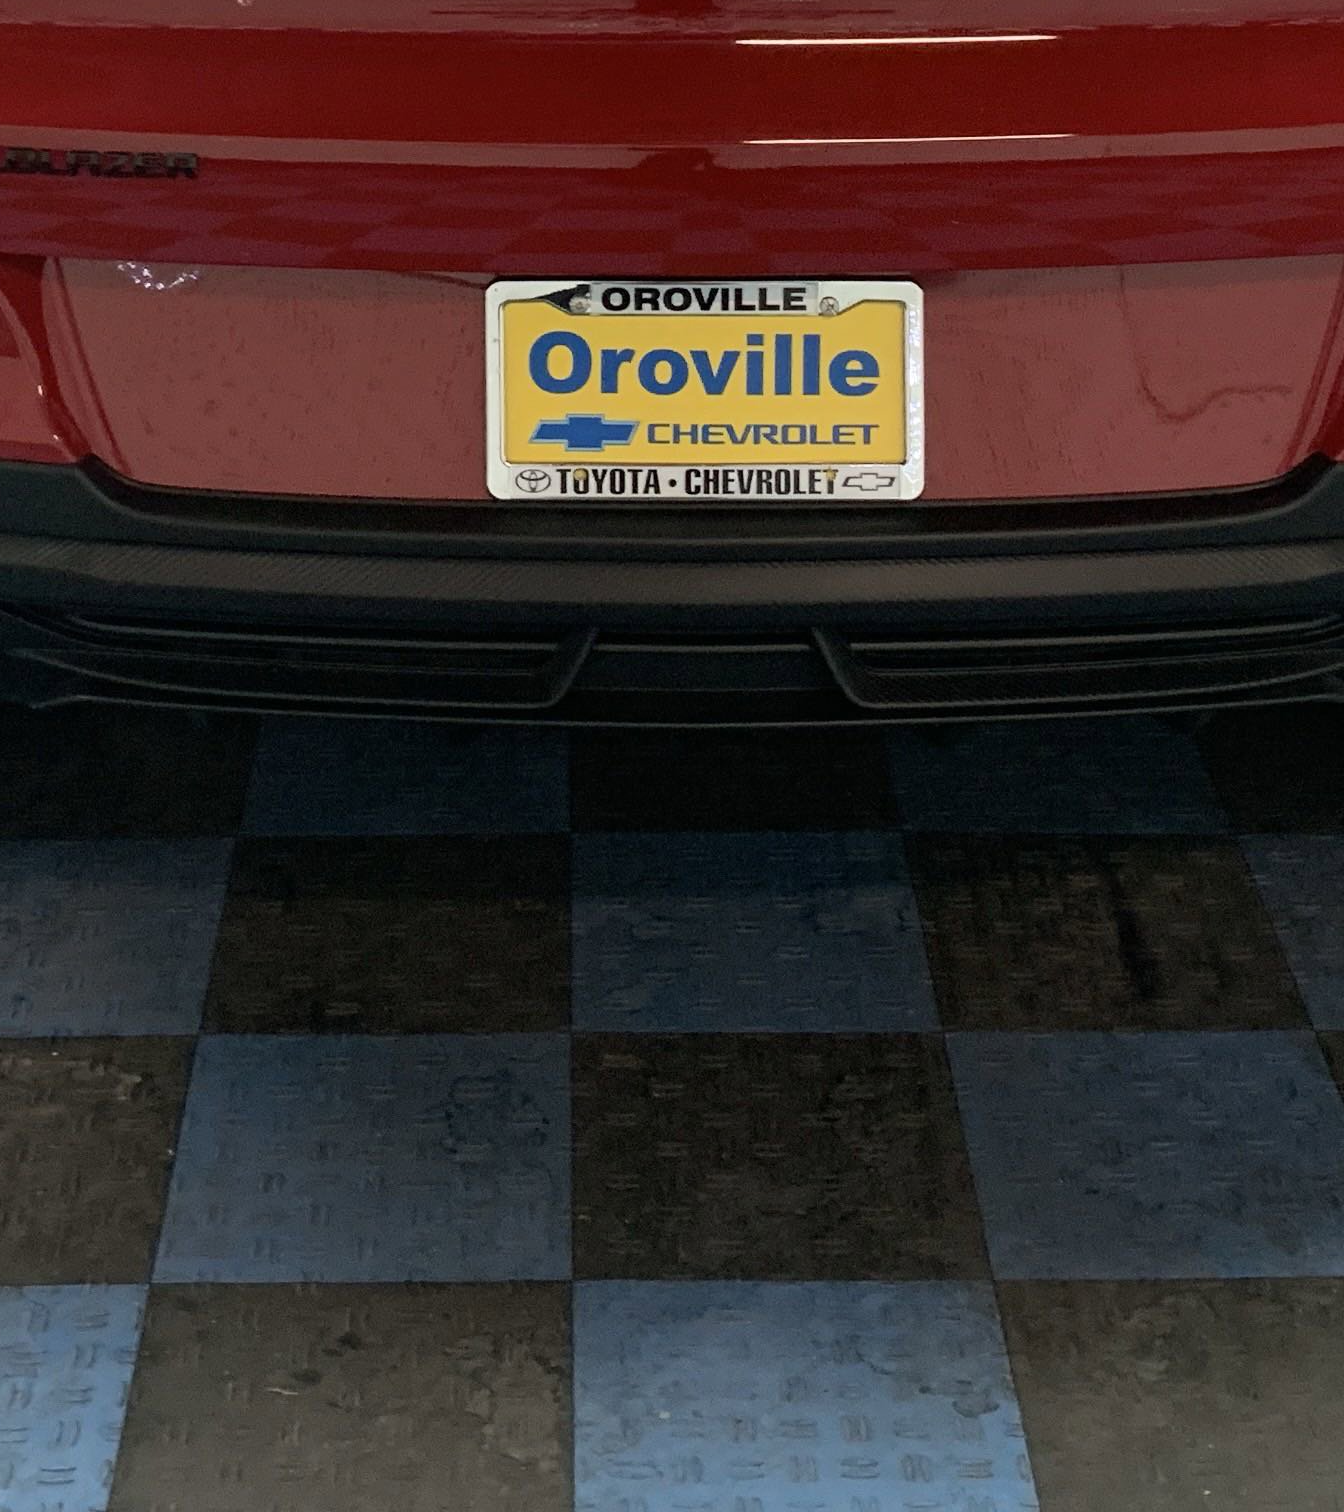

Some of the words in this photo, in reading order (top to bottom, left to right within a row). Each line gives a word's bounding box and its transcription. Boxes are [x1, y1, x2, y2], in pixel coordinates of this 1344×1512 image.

[601, 287, 808, 312] OROVILLE
[528, 330, 881, 396] Oroville
[647, 423, 880, 445] CHEVROLET
[557, 468, 660, 495] TOYOTA
[684, 468, 838, 495] CHEVROLET
